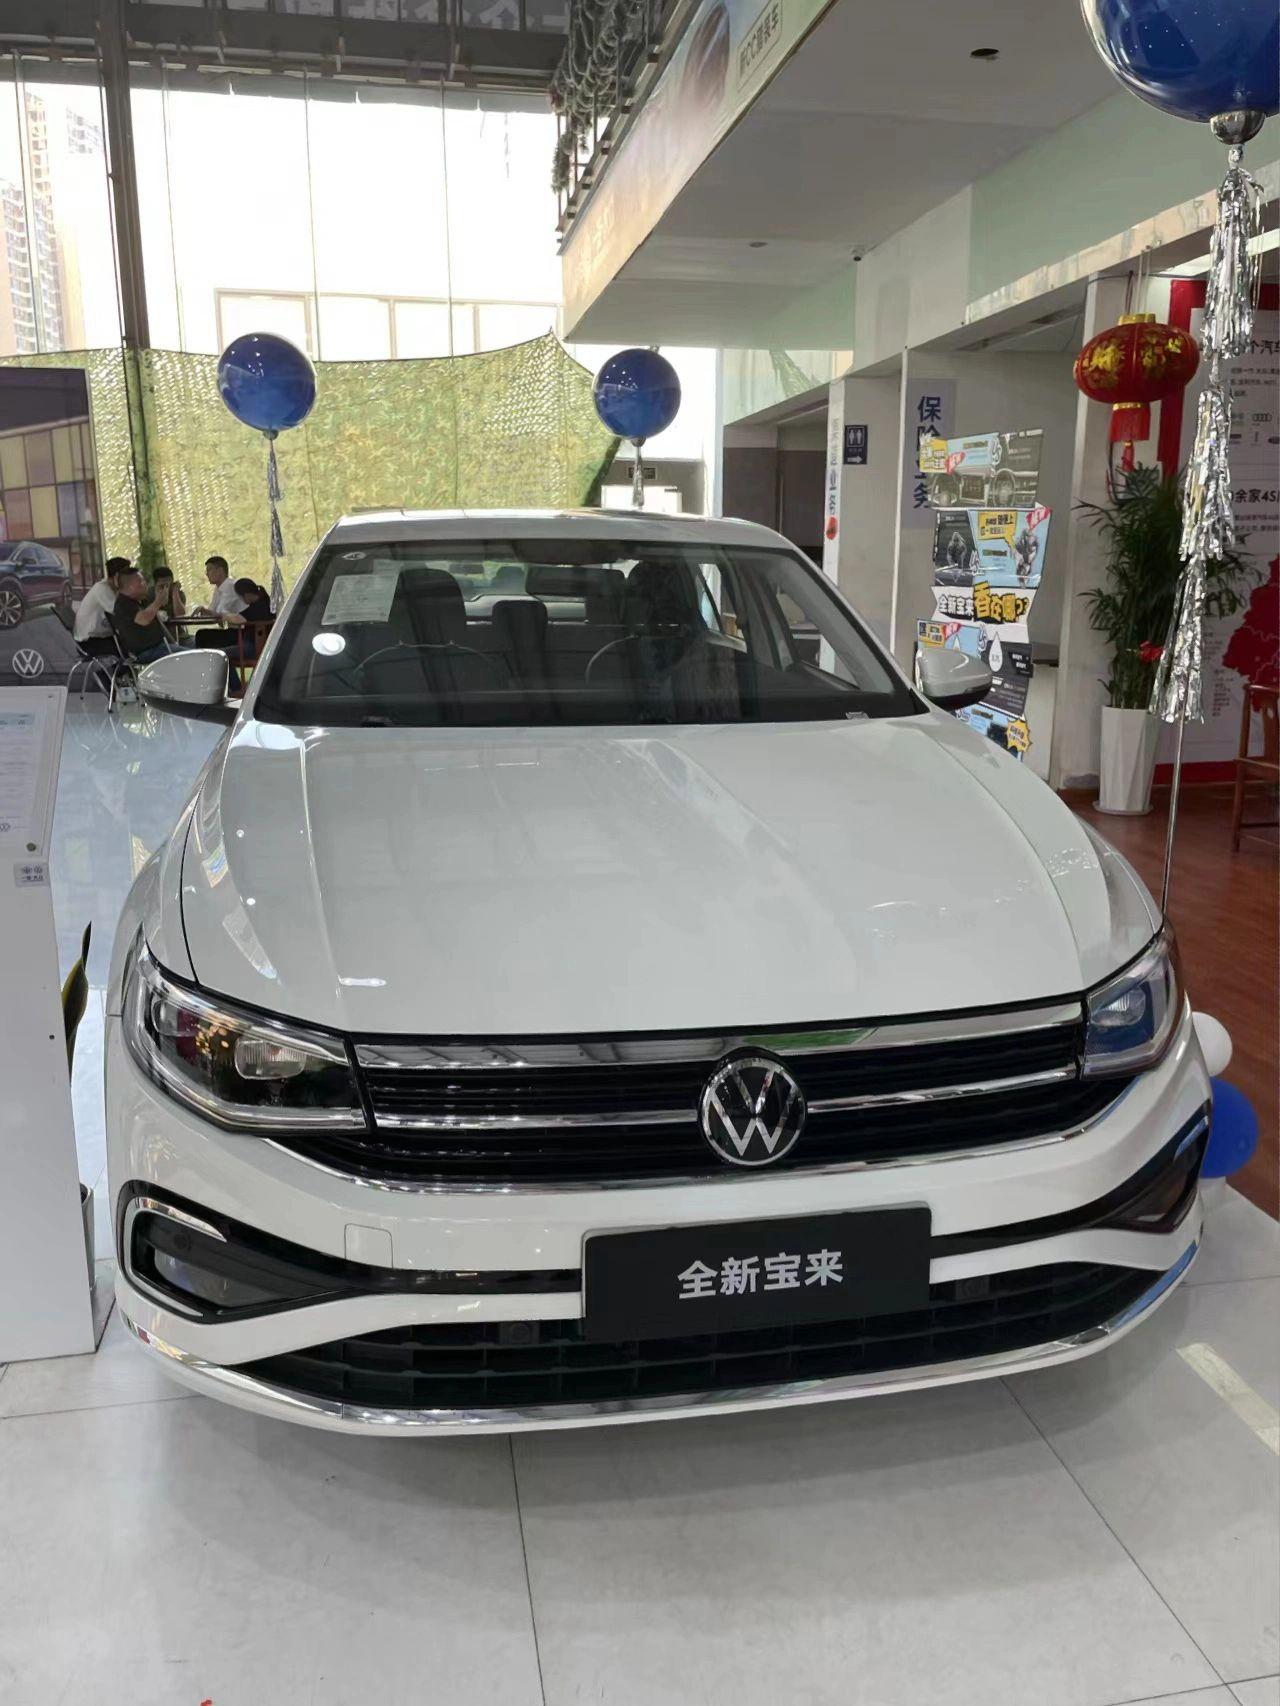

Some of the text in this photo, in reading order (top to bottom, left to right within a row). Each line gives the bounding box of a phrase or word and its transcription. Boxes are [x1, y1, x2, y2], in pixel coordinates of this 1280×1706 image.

[913, 396, 942, 509] 保务
[1231, 488, 1280, 503] 余家4S
[677, 1249, 844, 1300] 全新宝来
